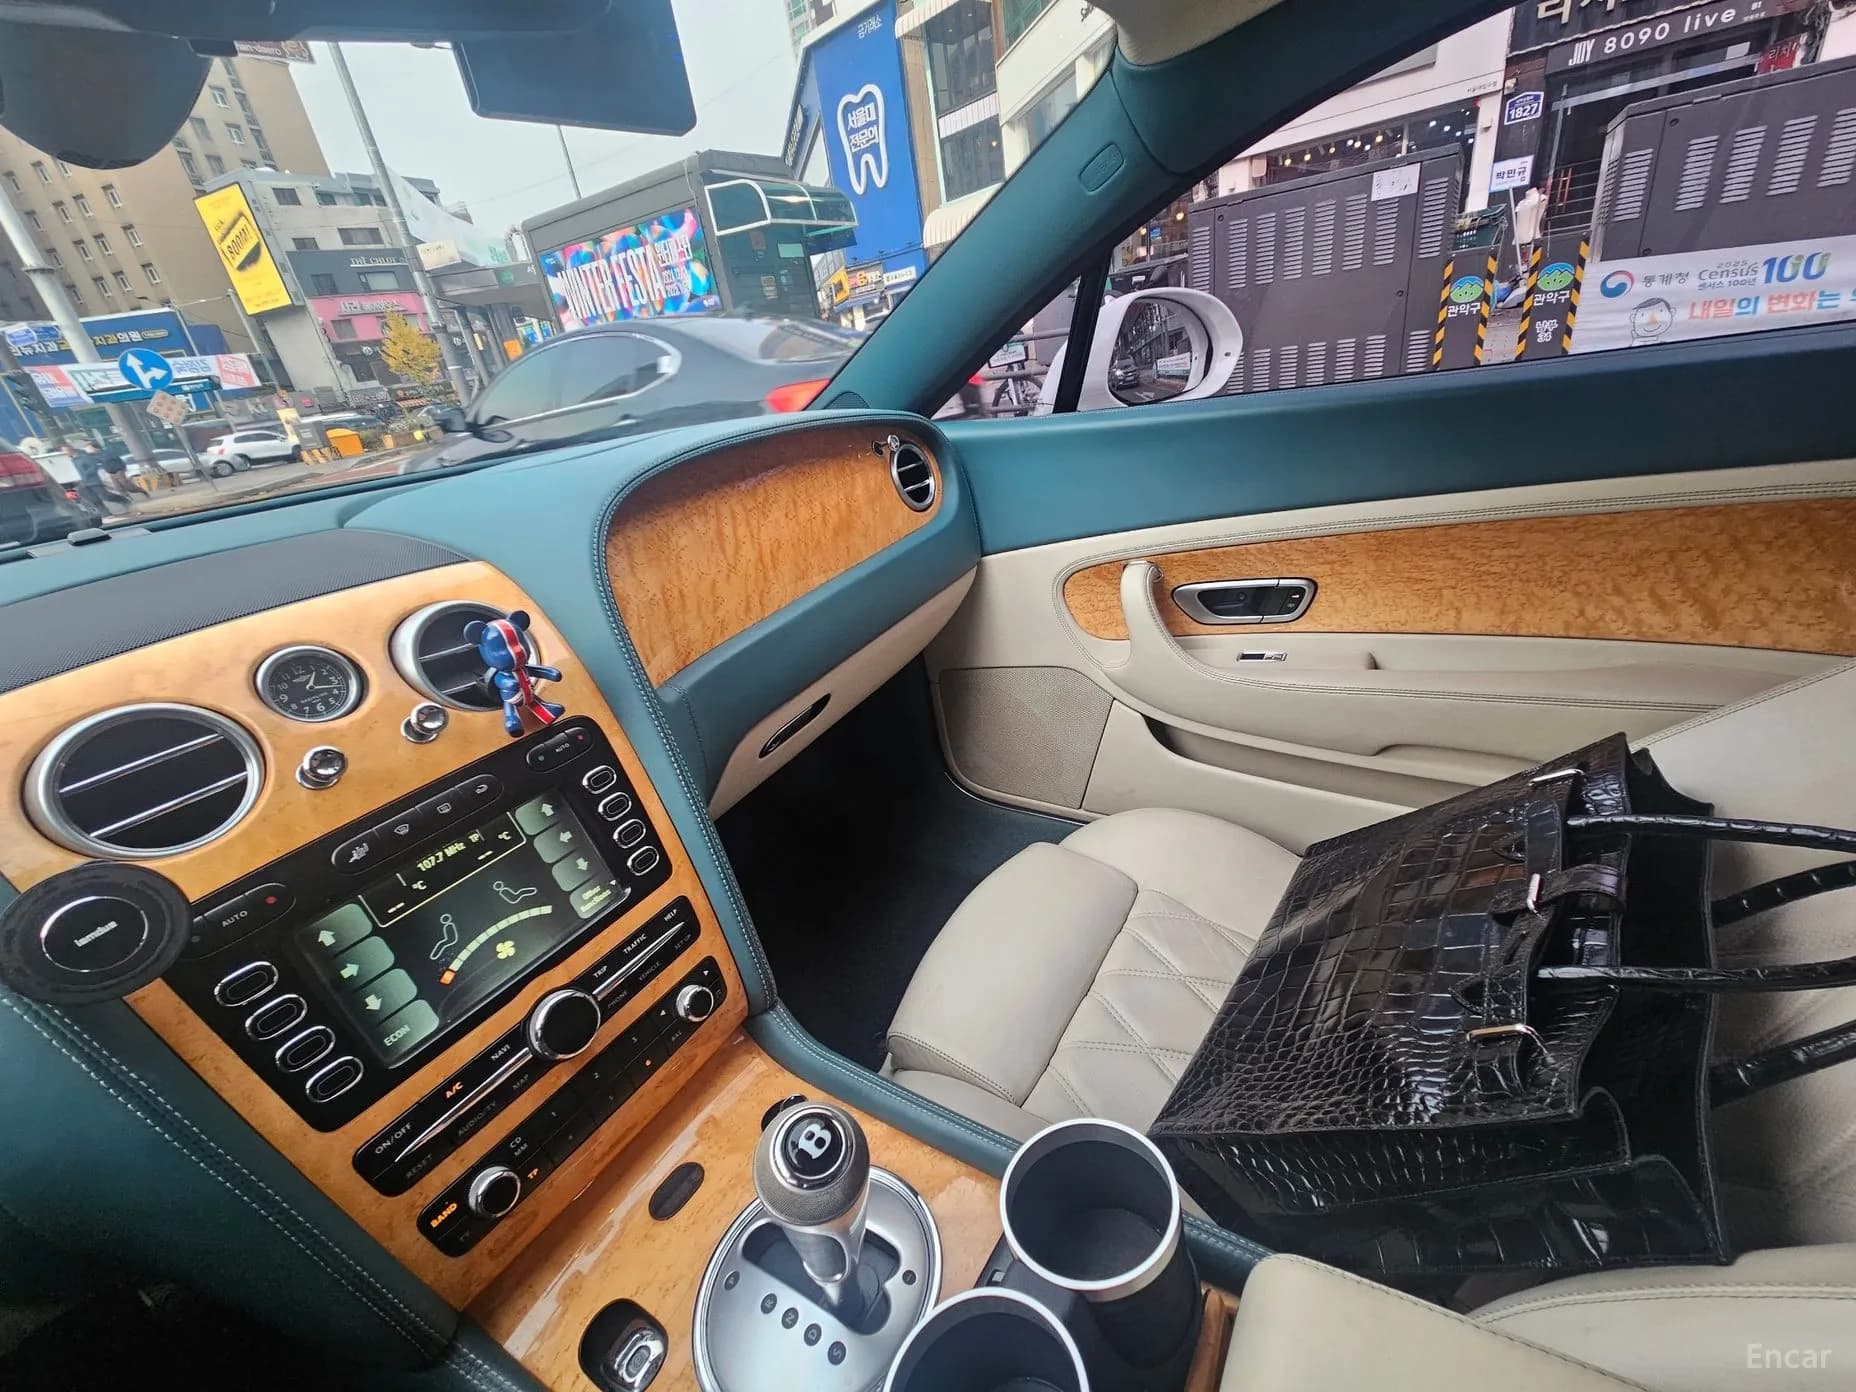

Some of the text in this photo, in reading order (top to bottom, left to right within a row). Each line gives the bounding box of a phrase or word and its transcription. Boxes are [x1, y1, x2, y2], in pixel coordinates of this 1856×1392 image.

[1604, 23, 1670, 54] 8090
[1683, 8, 1737, 33] live
[1509, 103, 1539, 120] 1827
[849, 125, 880, 153] 전문의
[1496, 166, 1527, 182] 박민규
[1698, 262, 1759, 281] Census
[1716, 259, 1749, 269] 2025
[1762, 249, 1832, 285] 100
[557, 259, 616, 321] WINTER
[610, 244, 667, 312] FESTA
[1641, 271, 1690, 288] 통계청
[1727, 277, 1757, 288] 100년
[1533, 290, 1570, 306] 관악구
[1688, 296, 1760, 320] 내일의
[1767, 290, 1841, 314] 변화는
[1447, 302, 1481, 318] 관악구
[316, 702, 325, 711] 6
[555, 742, 570, 753] AUTO
[416, 851, 444, 873] 107.7
[443, 842, 467, 857] MHz
[580, 889, 612, 914] functions
[582, 885, 601, 900] Other
[221, 909, 249, 928] AUTO
[664, 908, 678, 922] HELP
[623, 933, 647, 955] TRAFFIC
[593, 965, 608, 979] TRIP
[639, 961, 661, 982] VEHICLE
[383, 1023, 411, 1048] ECON
[491, 1044, 511, 1061] NAVI
[445, 1081, 464, 1099] A/C
[512, 1073, 530, 1090] MAP
[375, 1122, 412, 1155] ON/OFF
[509, 1136, 523, 1149] CD
[406, 1153, 433, 1179] RESET
[430, 1202, 458, 1228] BAND
